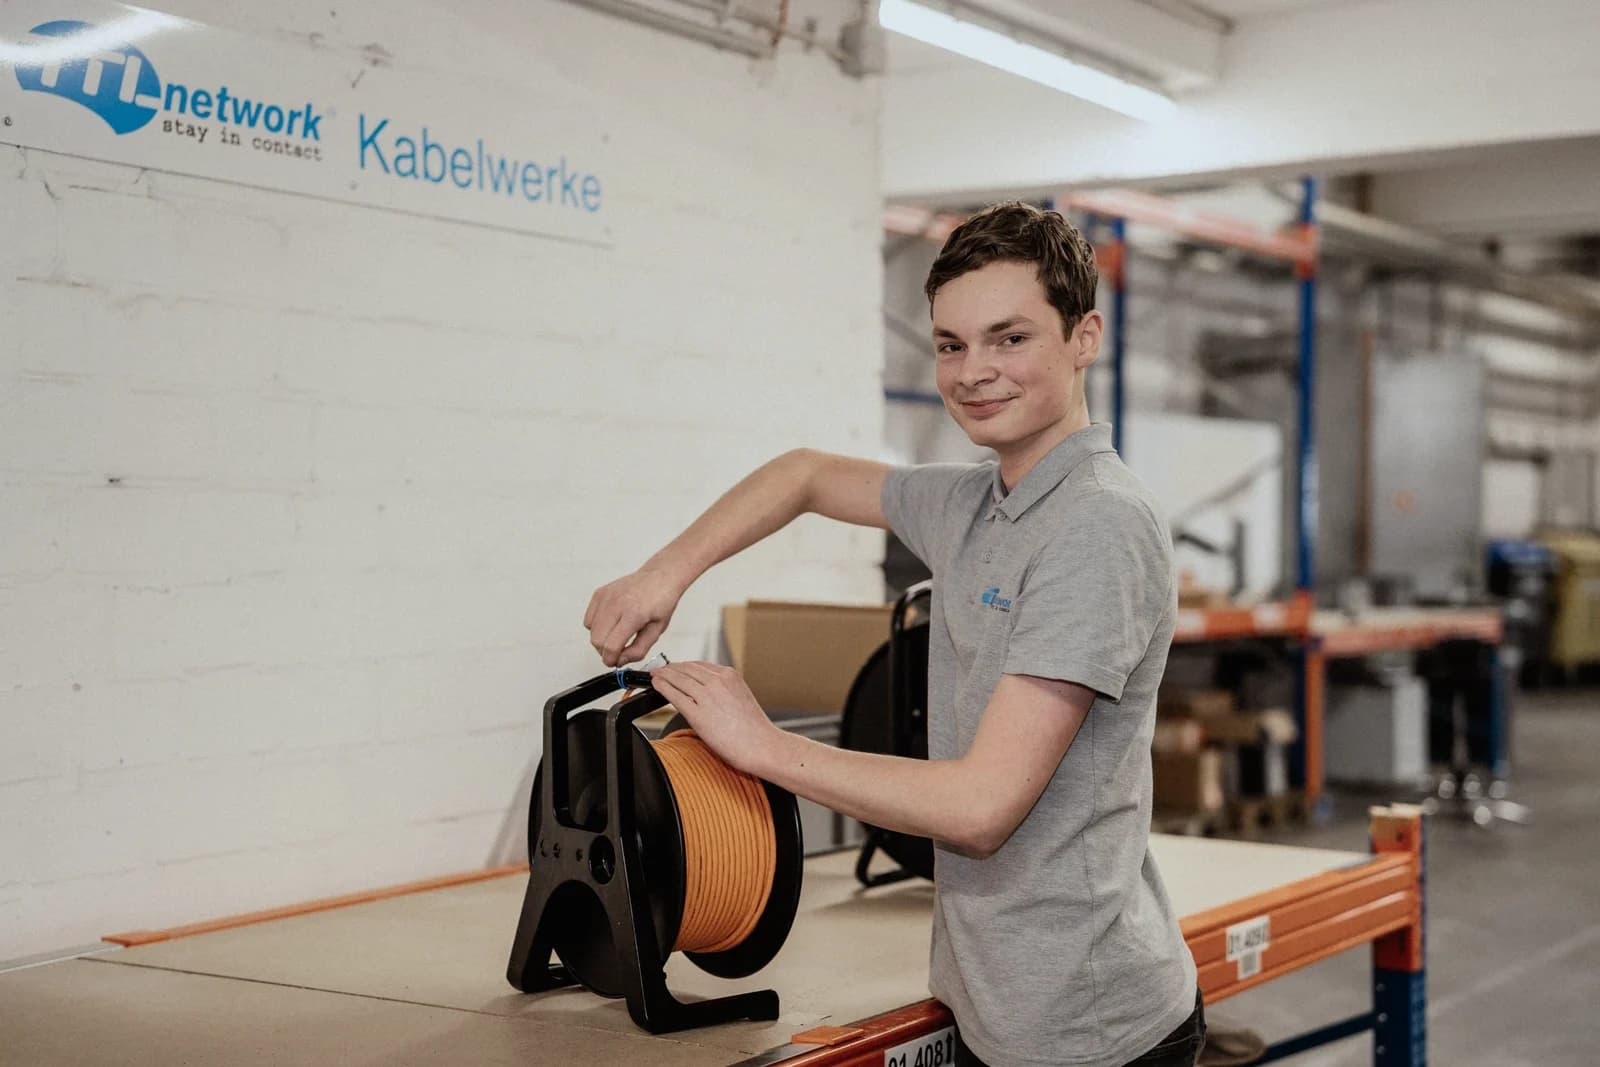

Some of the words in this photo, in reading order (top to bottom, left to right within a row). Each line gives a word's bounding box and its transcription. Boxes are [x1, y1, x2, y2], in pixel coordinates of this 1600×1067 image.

[162, 118, 208, 143] stay
[220, 124, 241, 146] in
[252, 135, 323, 162] contact
[163, 82, 322, 140] network
[358, 113, 601, 213] Kabelwerke
